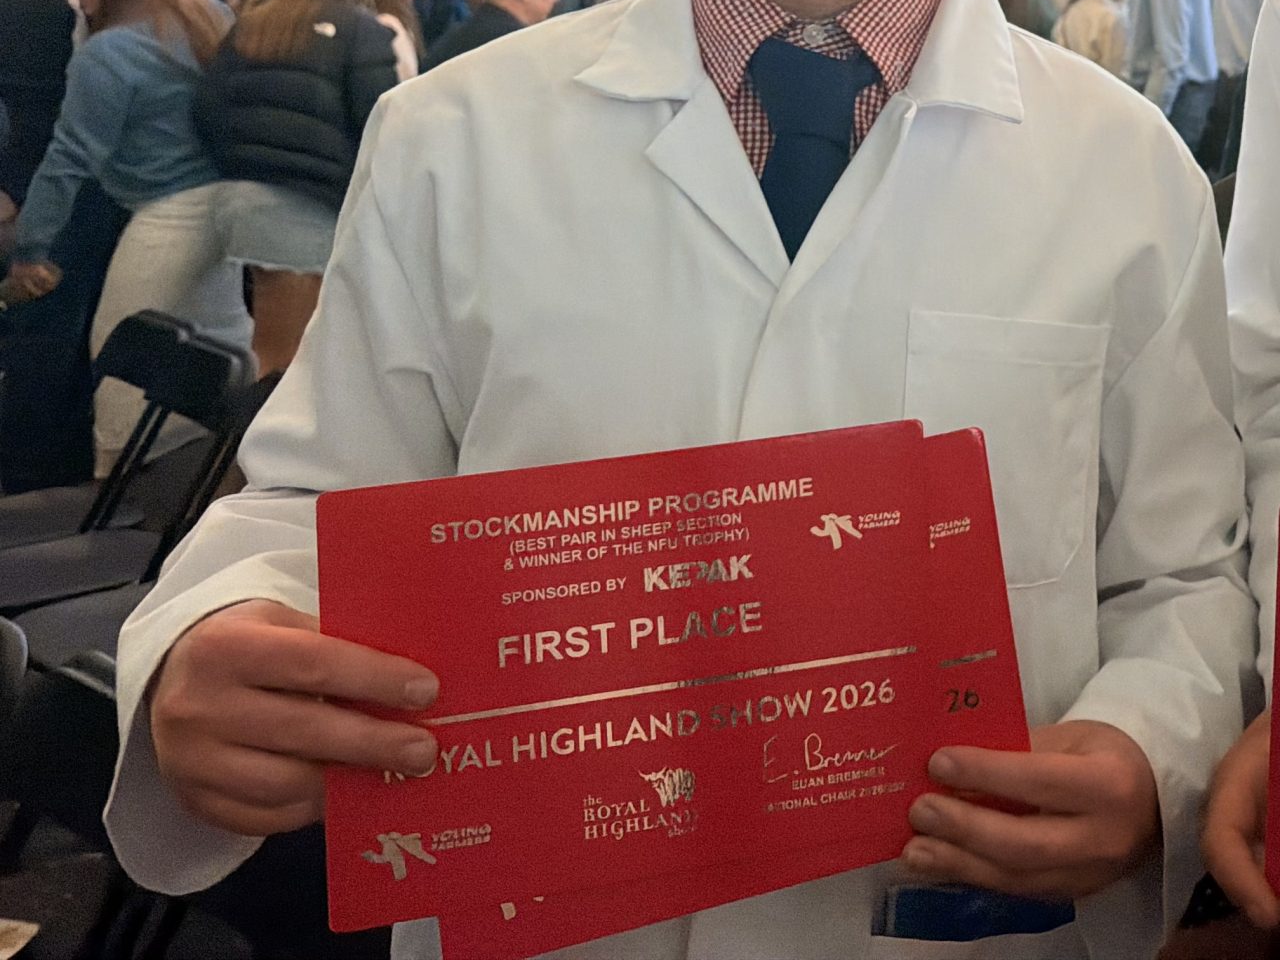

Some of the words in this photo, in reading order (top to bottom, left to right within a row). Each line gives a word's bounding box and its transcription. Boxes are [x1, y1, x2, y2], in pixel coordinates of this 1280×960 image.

[431, 500, 641, 544] STOCKMANSHIP
[648, 477, 814, 517] PROGRAMME
[509, 536, 556, 557] (BEST
[561, 531, 597, 546] PAIR
[601, 528, 617, 542] IN
[621, 521, 672, 539] SHEEP
[677, 513, 742, 532] SECTION
[504, 558, 515, 571] &
[519, 550, 583, 569] WINNER
[587, 546, 609, 560] OF
[612, 542, 643, 557] THE
[648, 537, 678, 553] NFU
[685, 527, 750, 547] TROPHY)
[501, 580, 601, 606] SPONSORED
[606, 576, 627, 592] BY
[643, 553, 754, 593] KEPAK
[498, 622, 616, 668] FIRST
[630, 601, 763, 650] PLACE
[512, 709, 701, 763] HIGHLAND
[709, 689, 812, 730] SHOW
[822, 678, 896, 714] 2026
[584, 799, 651, 822] ROYAL
